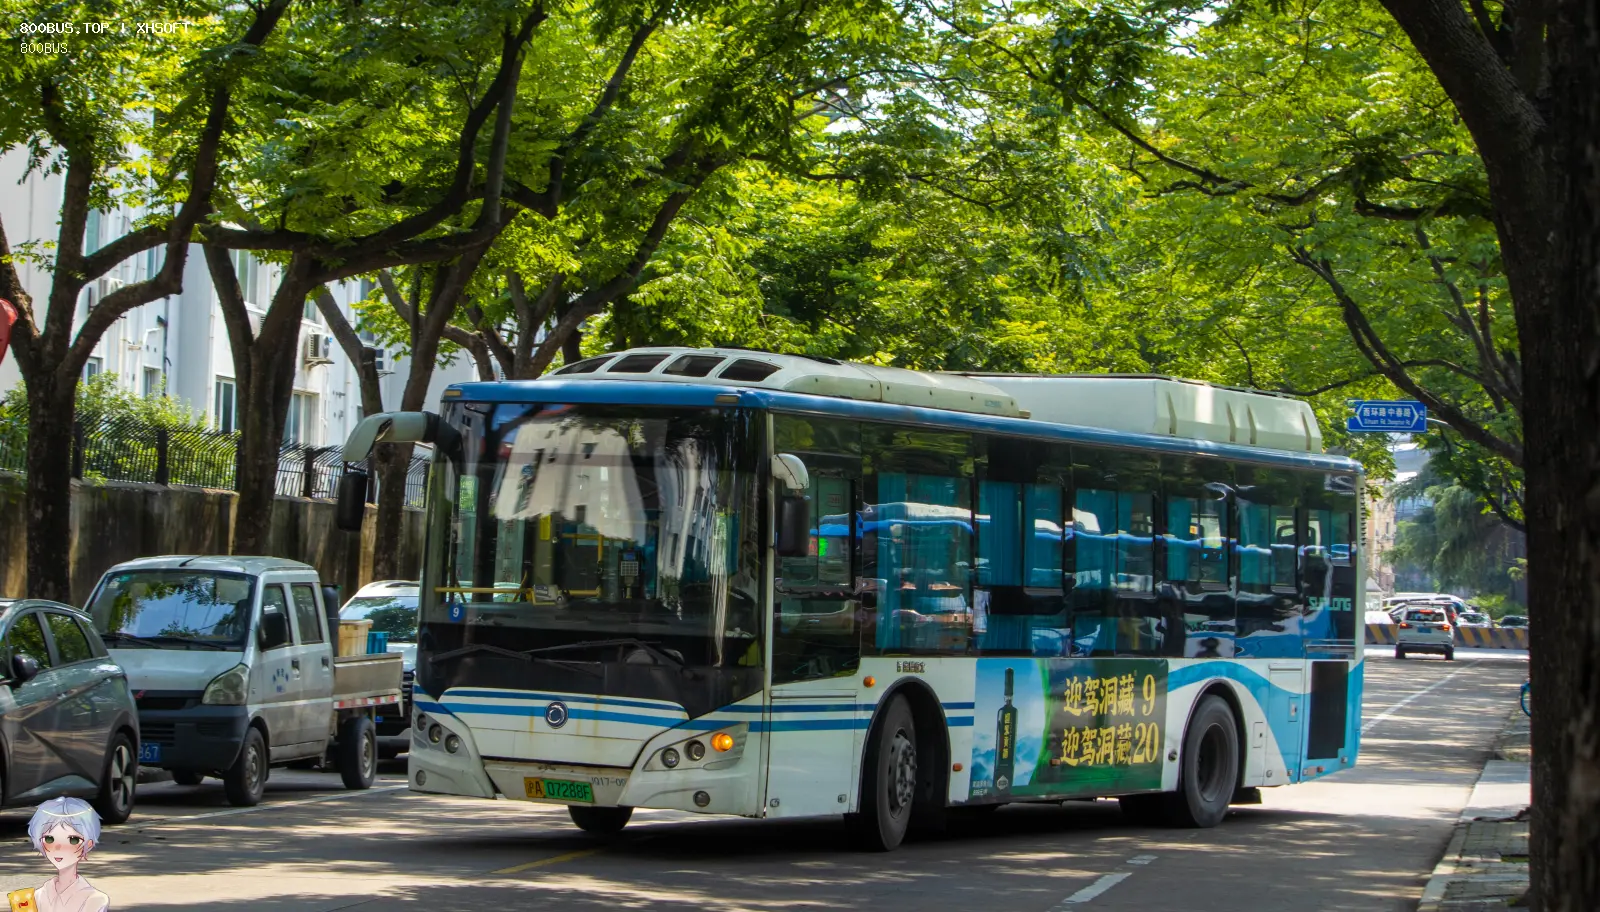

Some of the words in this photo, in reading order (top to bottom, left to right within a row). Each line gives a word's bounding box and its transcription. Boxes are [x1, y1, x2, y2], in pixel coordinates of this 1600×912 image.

[452, 607, 460, 618] 9
[1063, 673, 1135, 717] 迎驾洞藏
[1142, 674, 1156, 716] 9
